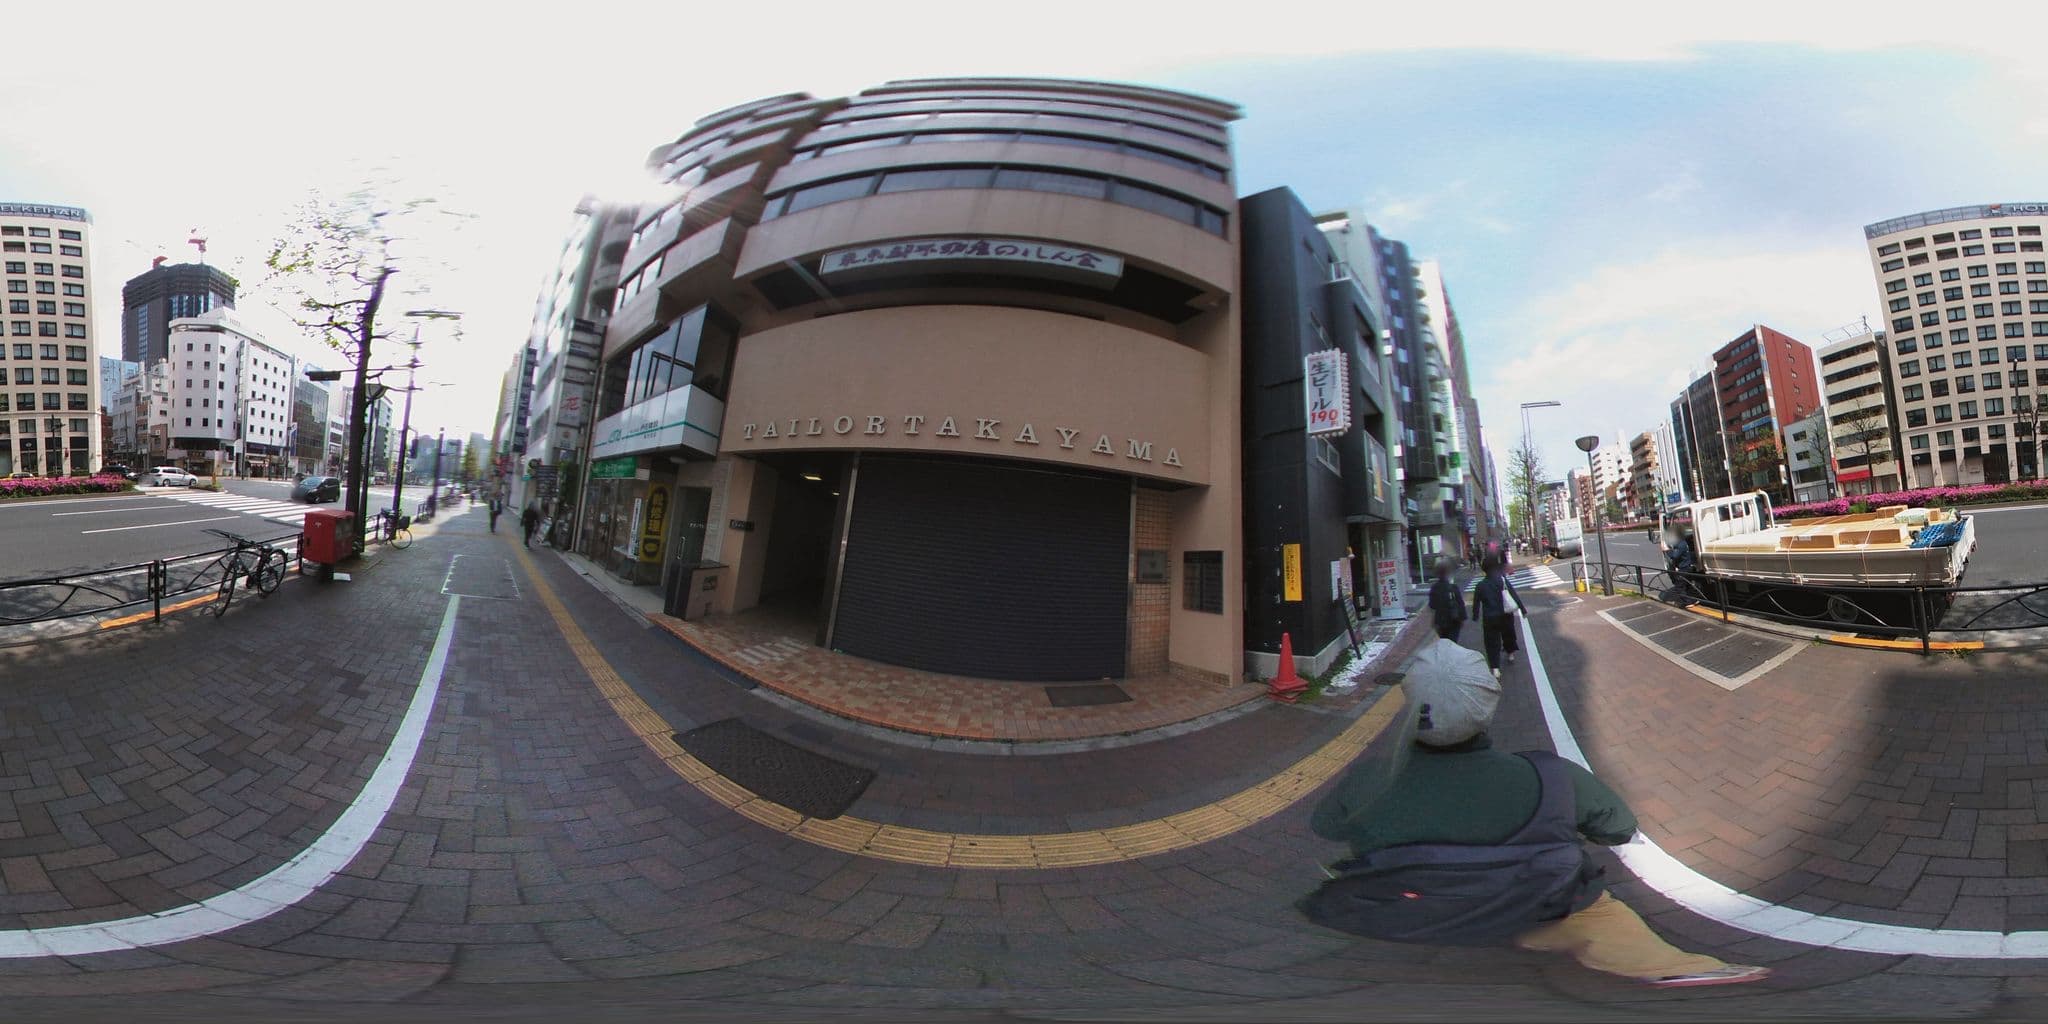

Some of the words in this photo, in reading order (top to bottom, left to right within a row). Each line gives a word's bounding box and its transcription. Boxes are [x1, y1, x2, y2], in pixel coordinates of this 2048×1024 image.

[22, 205, 81, 217] KEIHAN
[1310, 361, 1332, 411] 生ビール
[1311, 409, 1339, 424] 190
[743, 415, 886, 440] TAILOR
[904, 415, 1184, 468] TAKAYAMA
